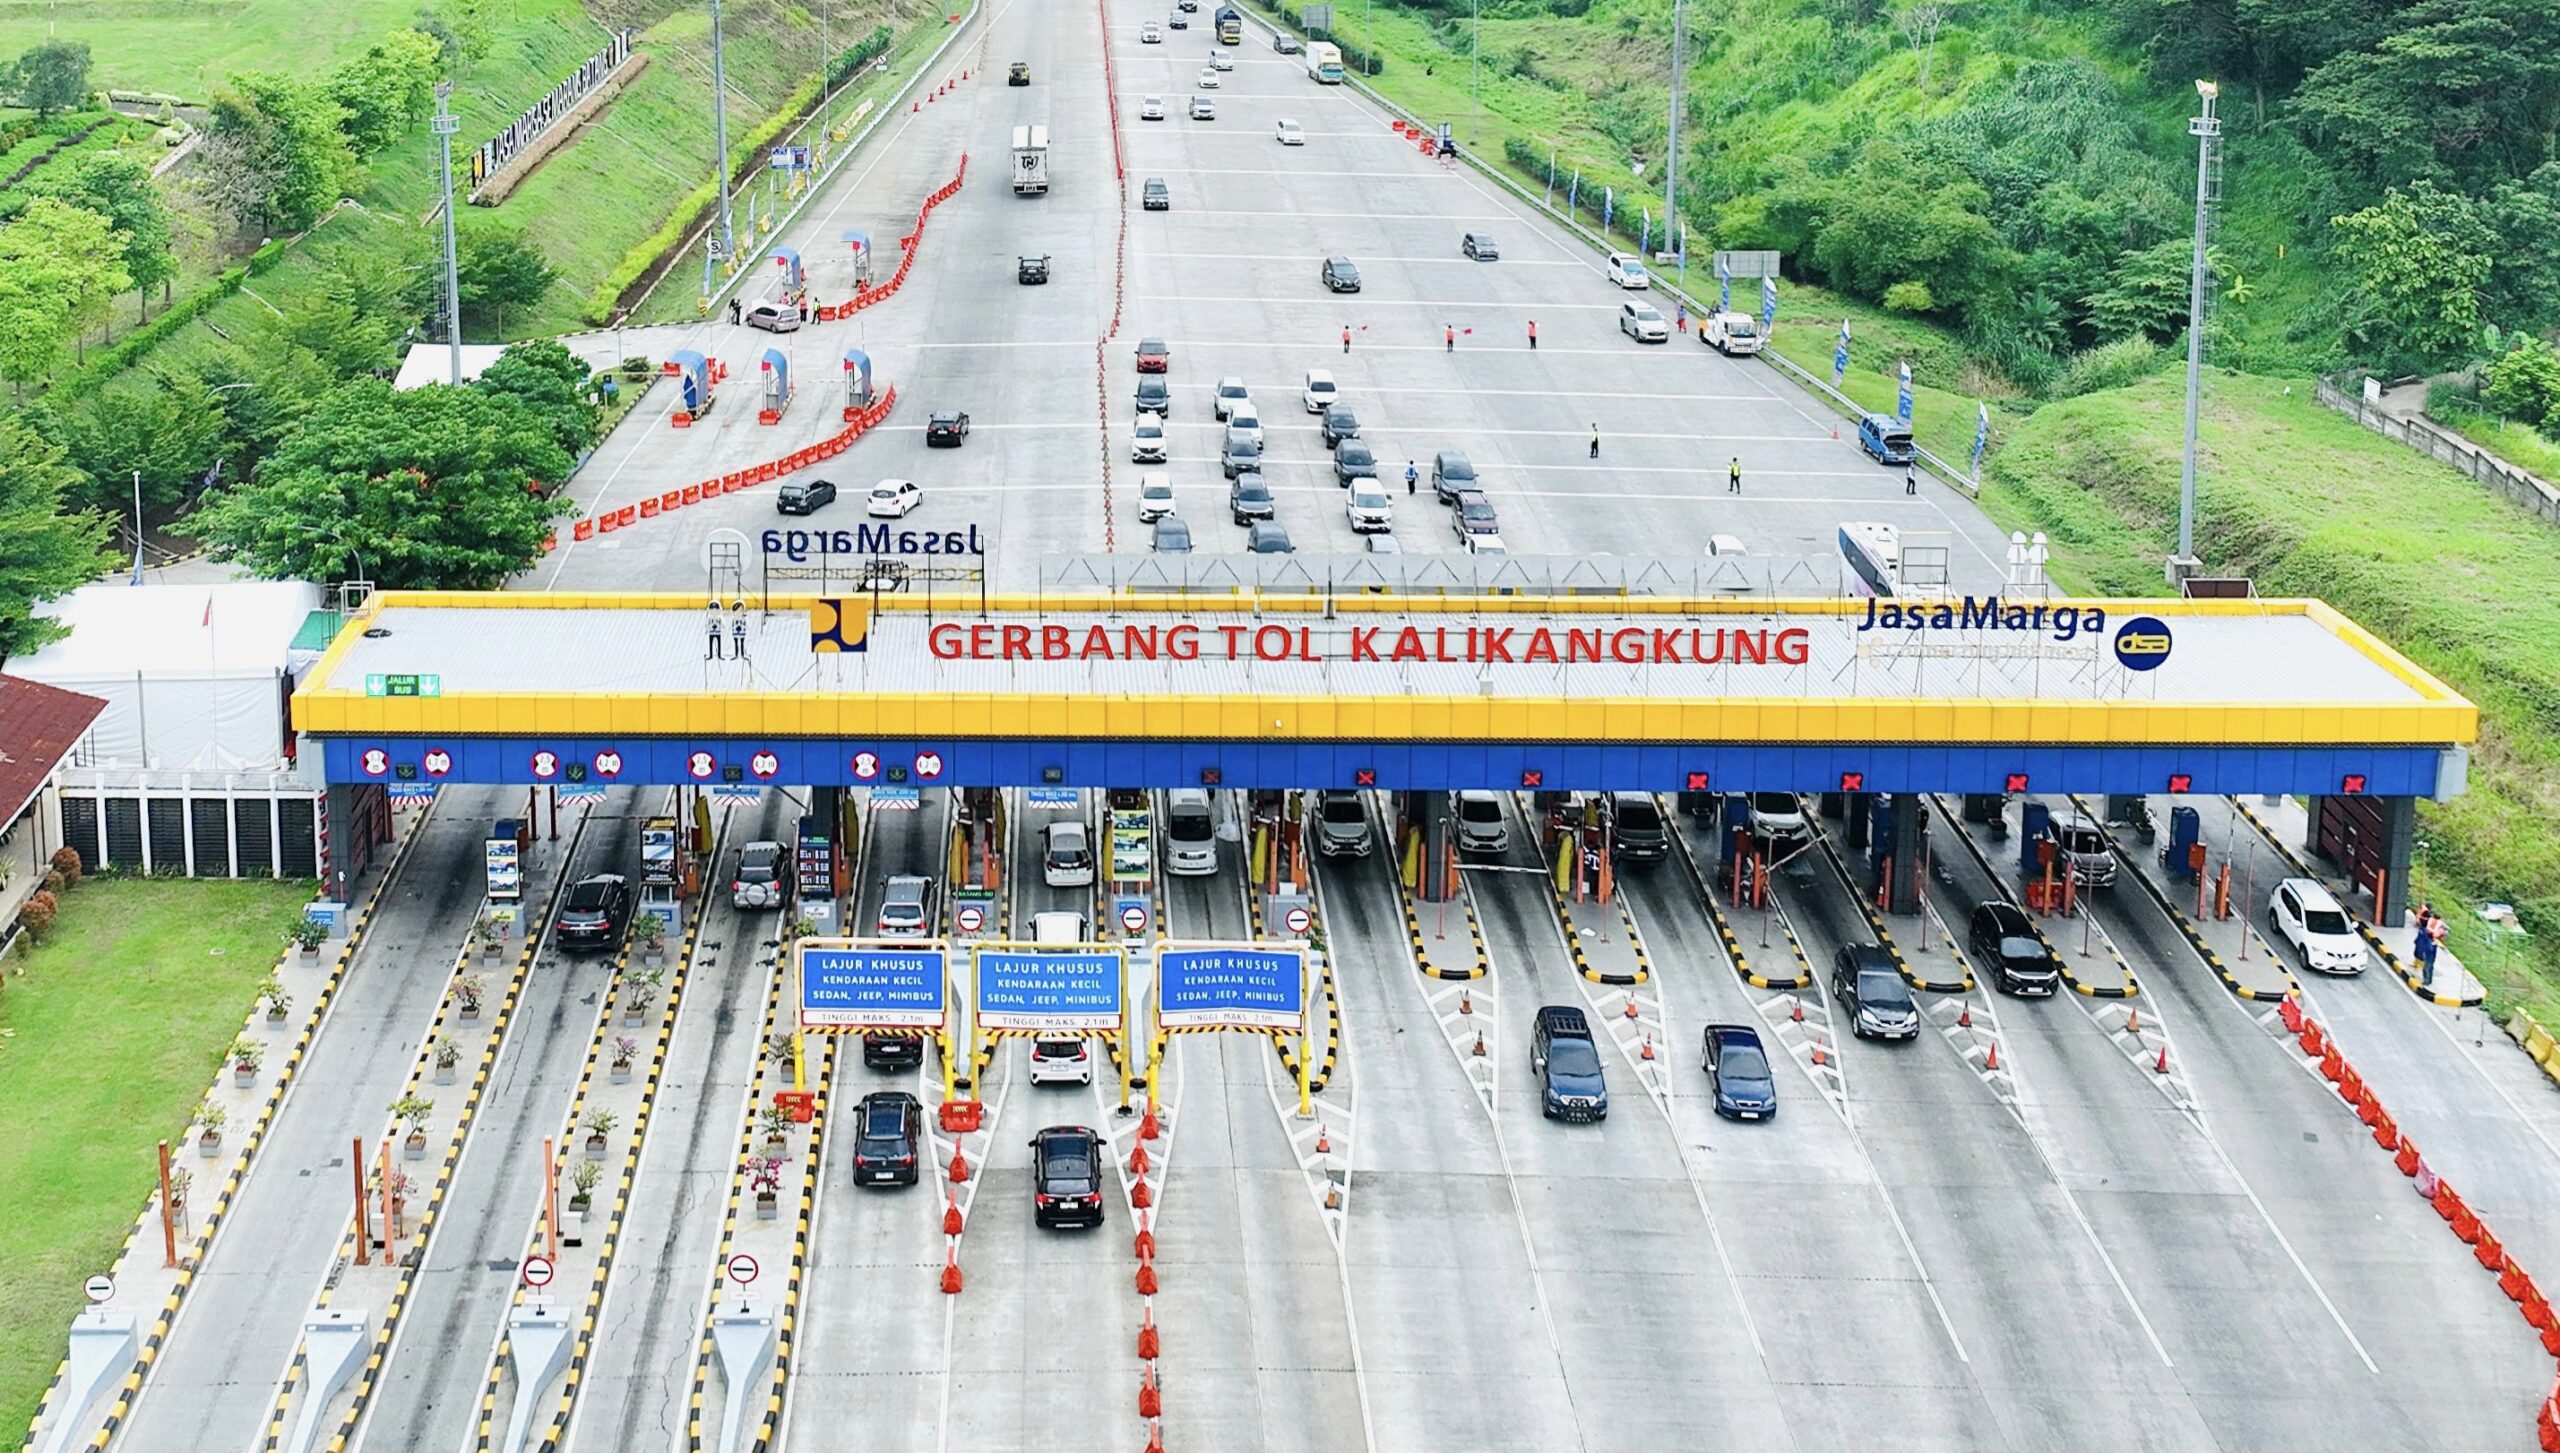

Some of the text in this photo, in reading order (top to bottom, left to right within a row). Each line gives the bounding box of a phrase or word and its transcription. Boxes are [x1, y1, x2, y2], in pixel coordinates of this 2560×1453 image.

[1857, 596, 2105, 641] JasaMarga
[928, 623, 1809, 665] GERBANG TOL KALIKANGKUNG
[822, 959, 924, 970] LAJUR KHUSUS
[995, 962, 1104, 974] LAJUR KHUSUS
[1183, 958, 1279, 972] LAJUR KHUSUS
[822, 976, 923, 985] KENDARAAN KECIL
[997, 979, 1102, 989] KENDARAAN KECIL
[1184, 975, 1277, 986] KENDARAAN KECIL
[888, 992, 934, 1001] MINIBUS
[1065, 995, 1112, 1004] MINIBUS
[1244, 991, 1285, 1002] MINIBUS
[822, 1014, 858, 1022] TINGGI
[1002, 1017, 1040, 1025] TINGGI
[1189, 1014, 1218, 1022] TINGGI
